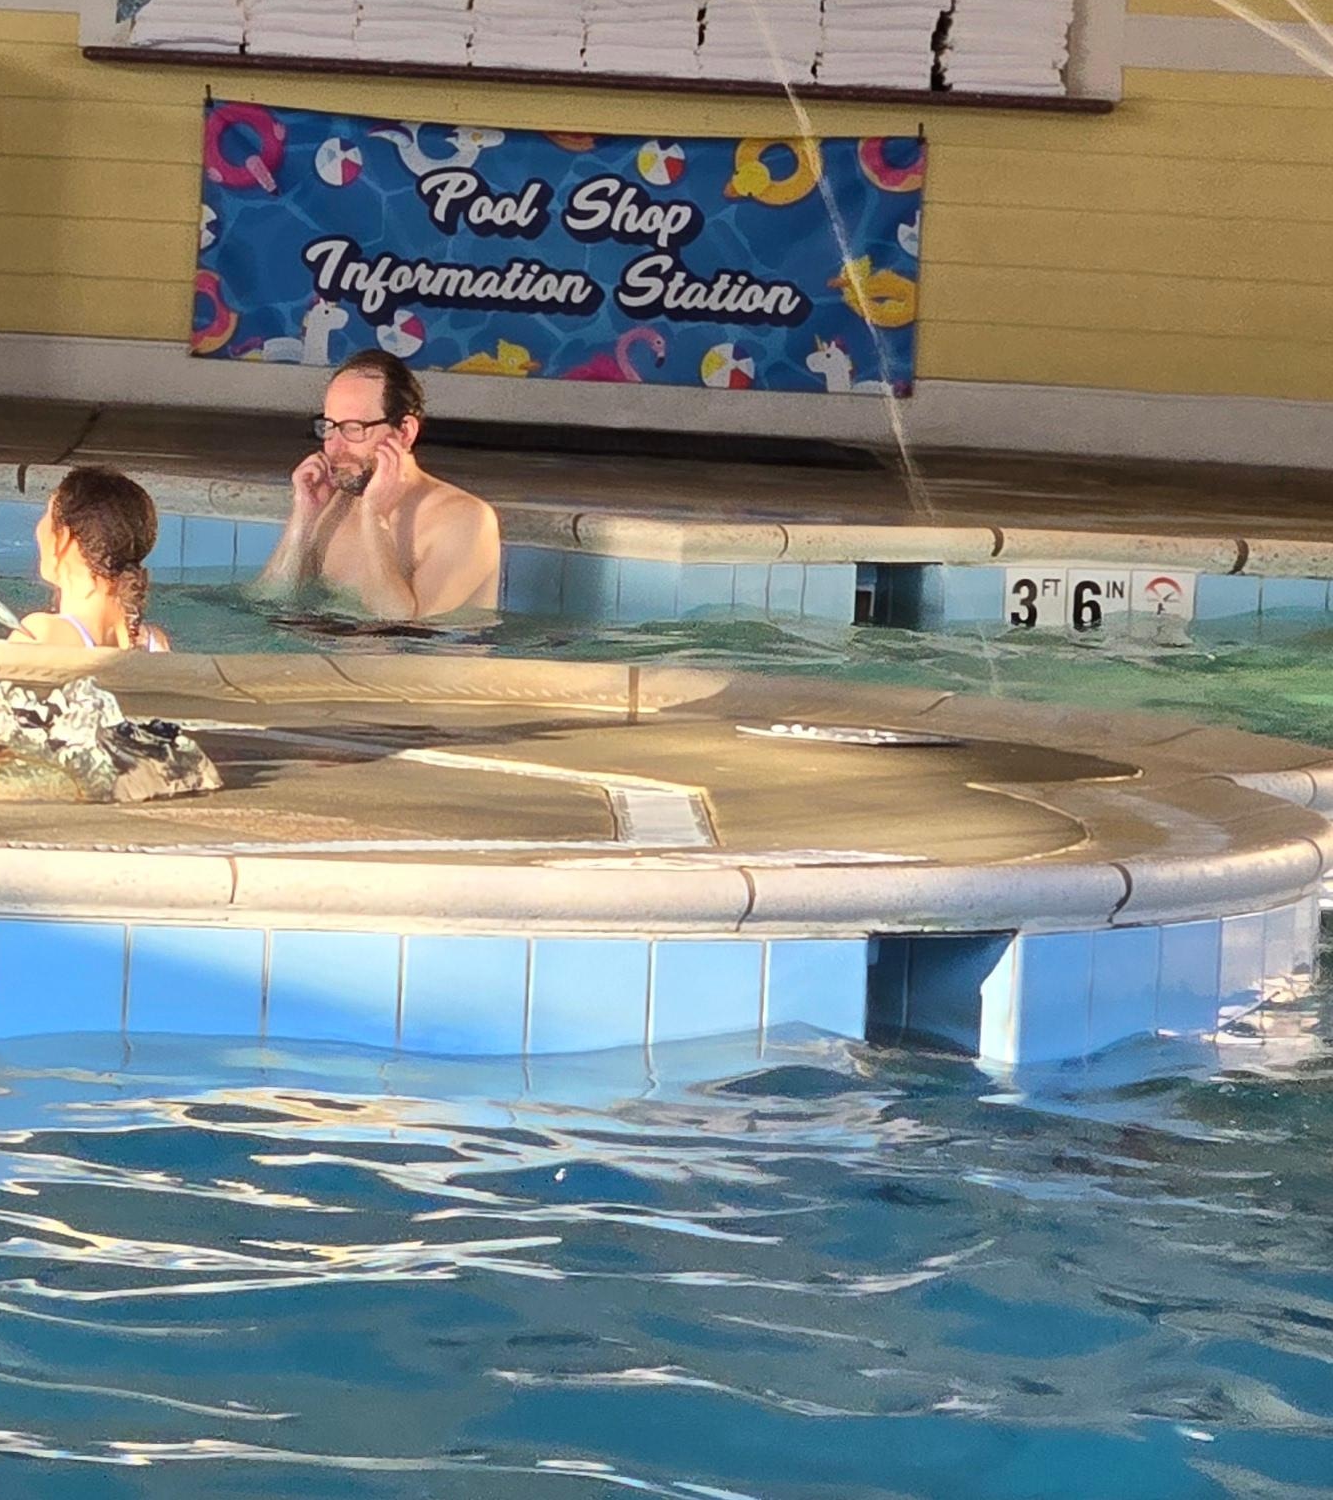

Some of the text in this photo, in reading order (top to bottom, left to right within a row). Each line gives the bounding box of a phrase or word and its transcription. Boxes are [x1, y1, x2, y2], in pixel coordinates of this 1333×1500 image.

[422, 173, 693, 247] Pool Shop
[305, 240, 801, 315] Information Station
